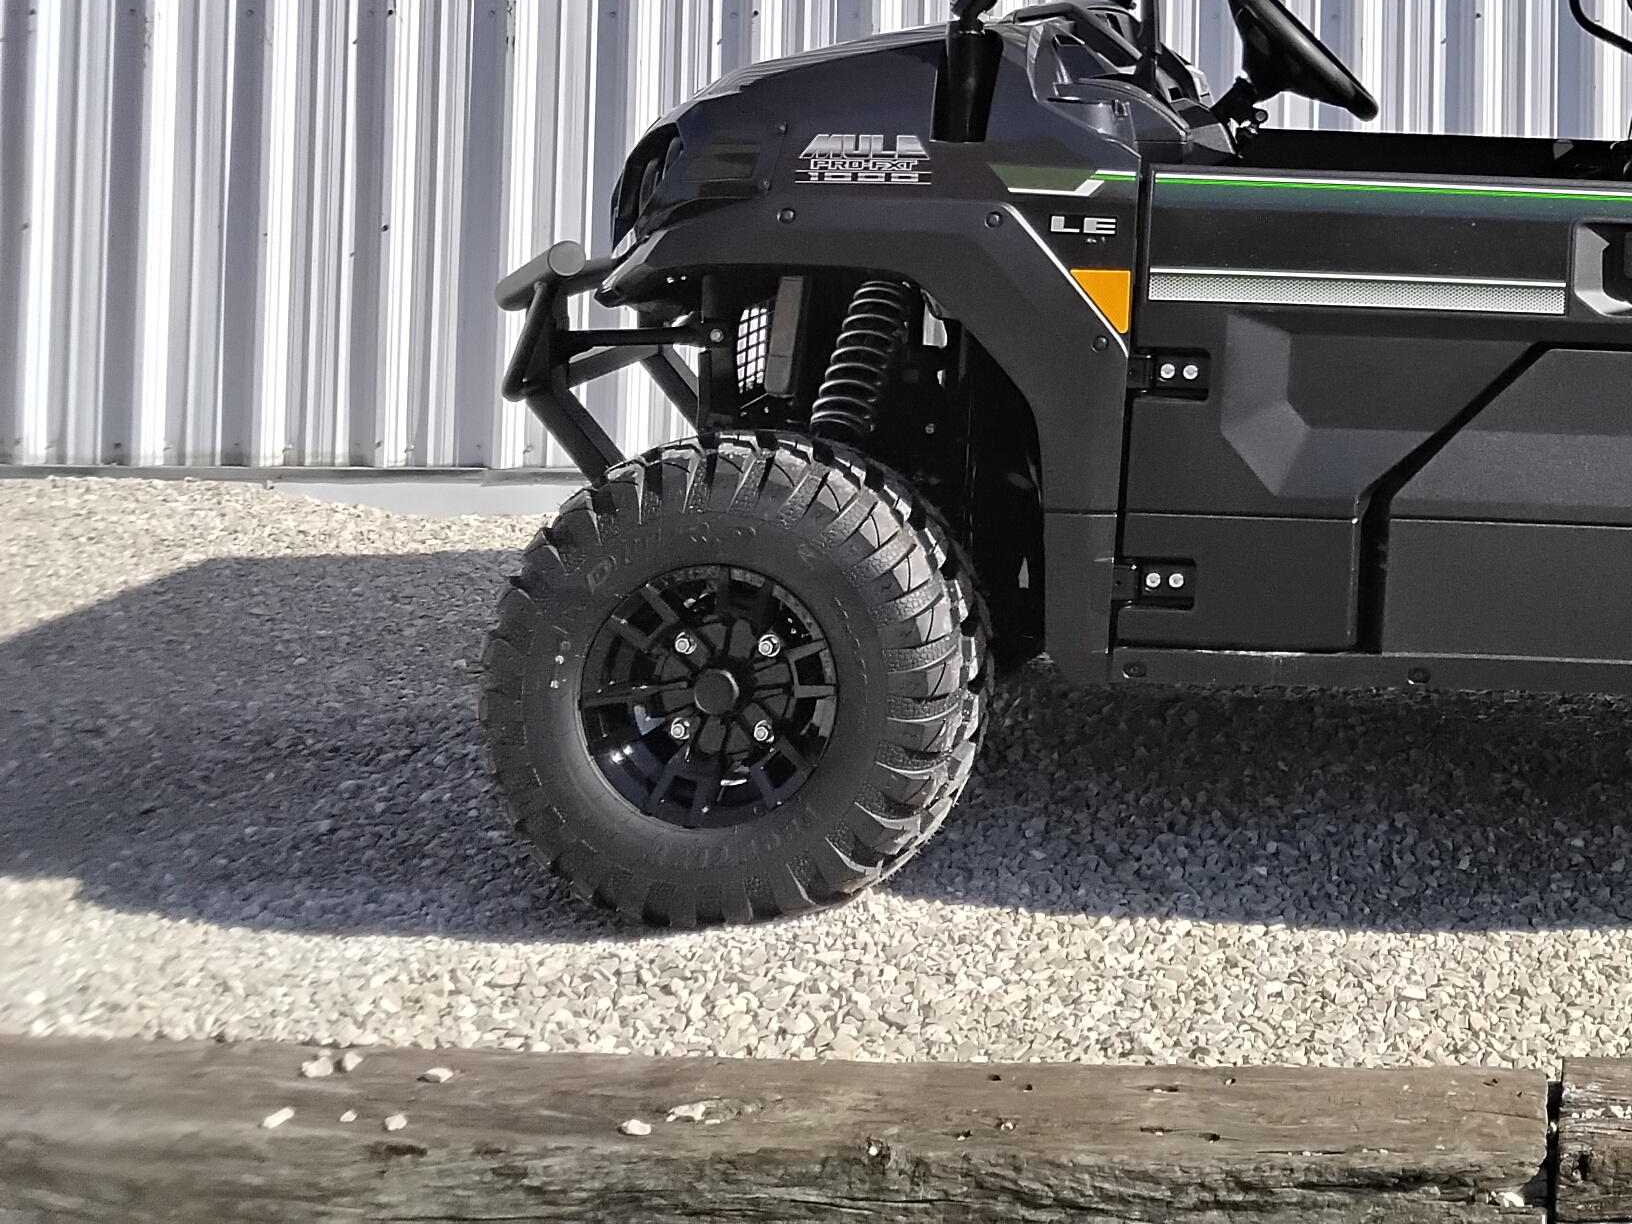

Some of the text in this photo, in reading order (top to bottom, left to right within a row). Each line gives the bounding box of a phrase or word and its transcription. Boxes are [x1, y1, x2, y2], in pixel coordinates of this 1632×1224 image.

[799, 134, 930, 160] MULE
[808, 172, 920, 182] 1000
[1050, 215, 1117, 235] LE
